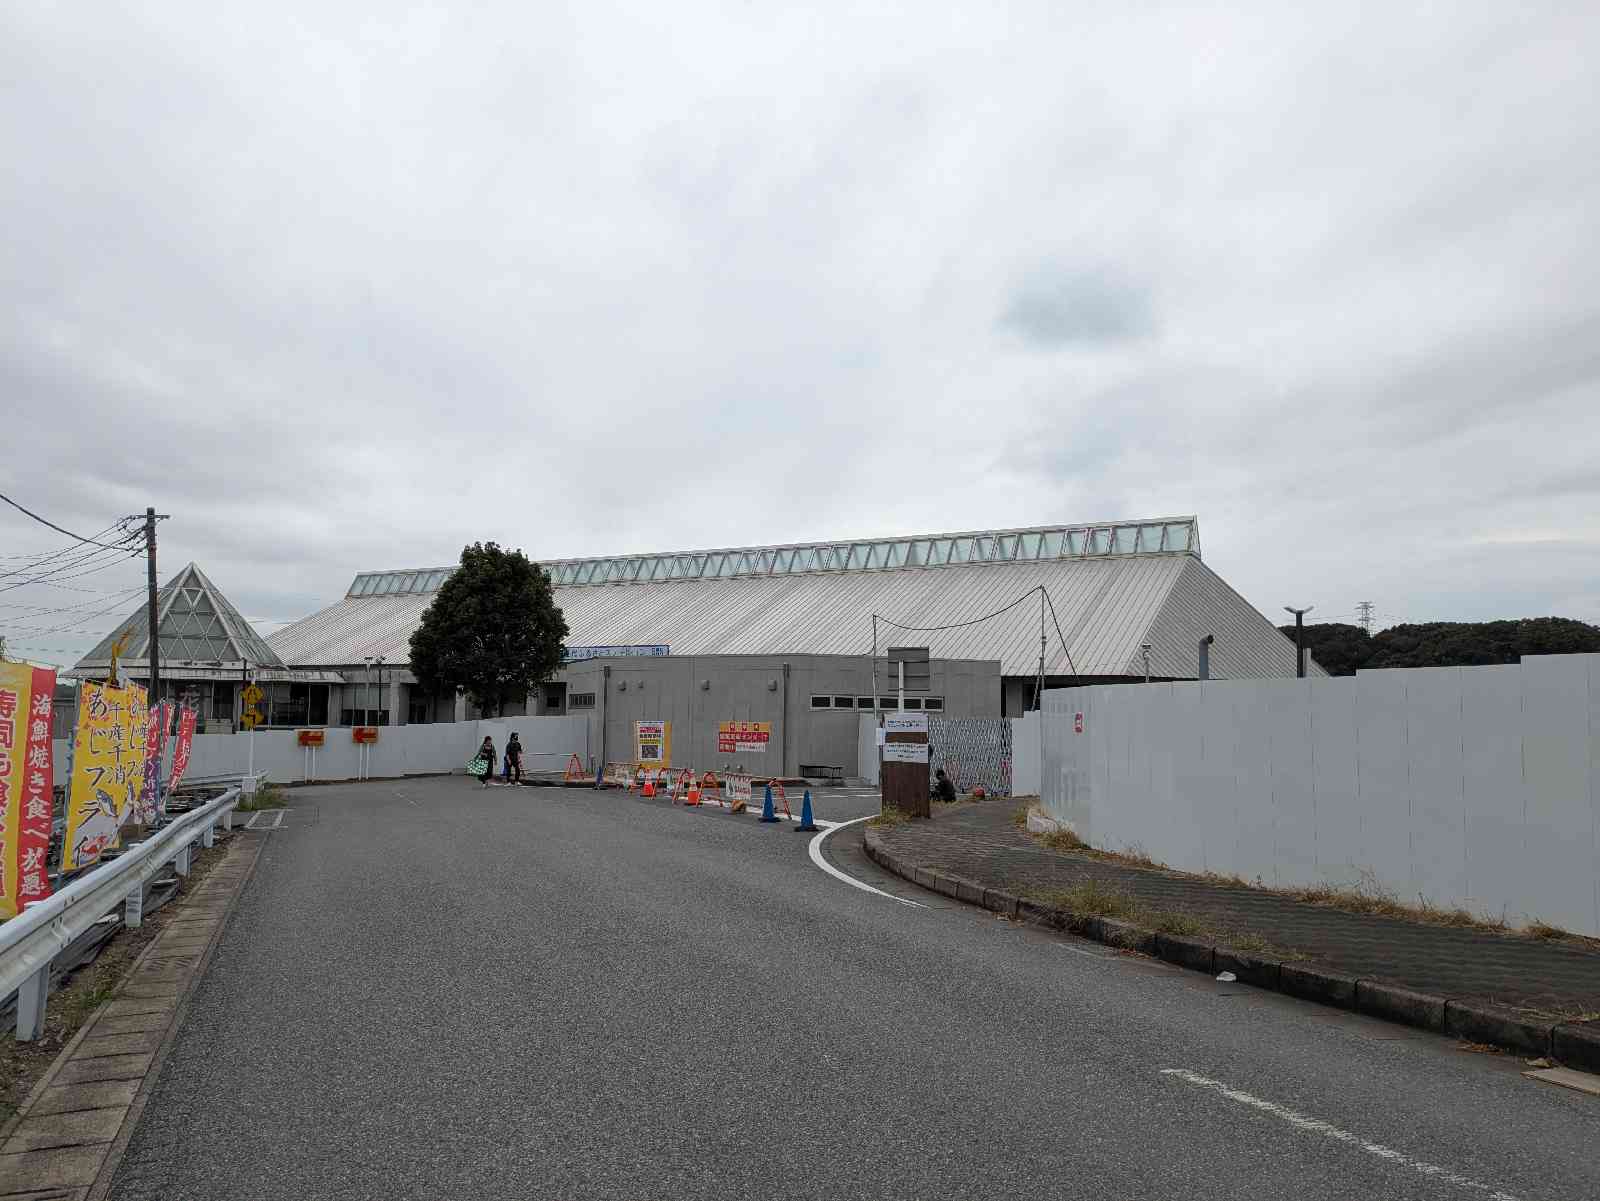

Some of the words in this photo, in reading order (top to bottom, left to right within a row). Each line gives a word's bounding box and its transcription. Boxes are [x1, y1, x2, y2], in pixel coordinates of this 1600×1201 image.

[19, 693, 52, 897] 海鮮焼き食べ放題
[71, 687, 108, 868] あじフライ
[107, 702, 128, 785] 千産千消
